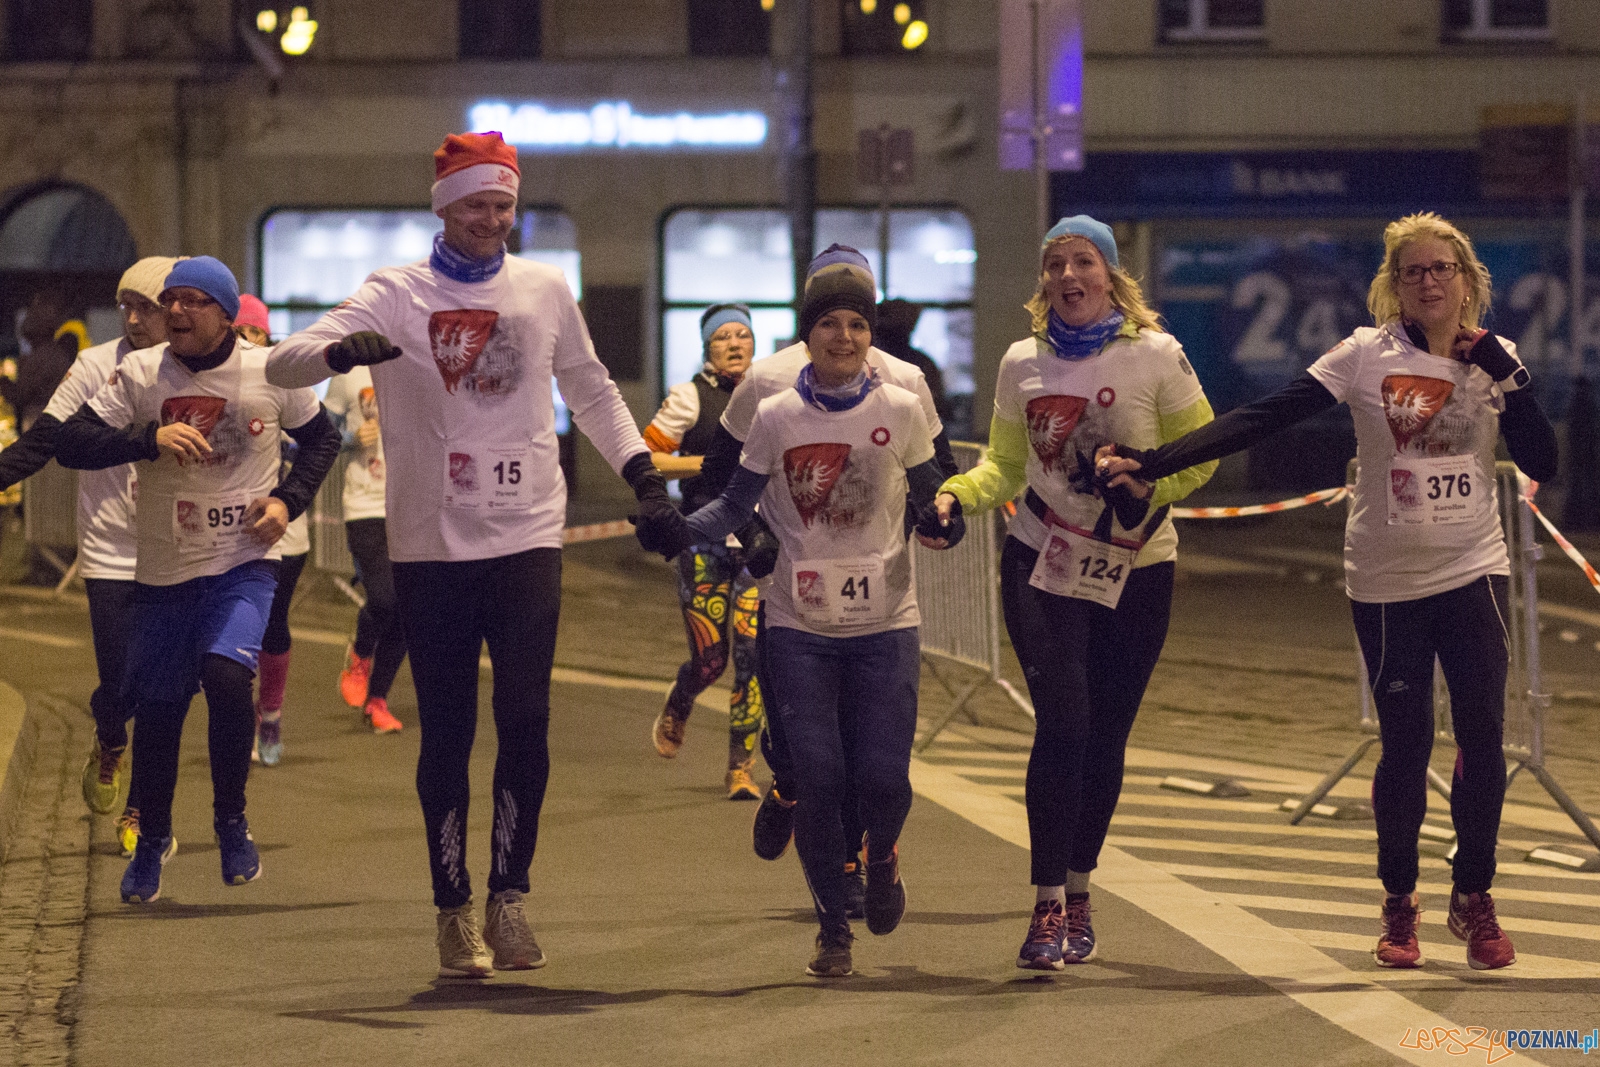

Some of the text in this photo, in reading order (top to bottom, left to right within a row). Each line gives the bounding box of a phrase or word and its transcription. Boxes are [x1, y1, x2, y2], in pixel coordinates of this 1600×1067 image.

[494, 461, 521, 485] 15
[1427, 473, 1471, 500] 376
[207, 504, 246, 528] 957
[1079, 556, 1124, 584] 124
[841, 576, 869, 600] 41
